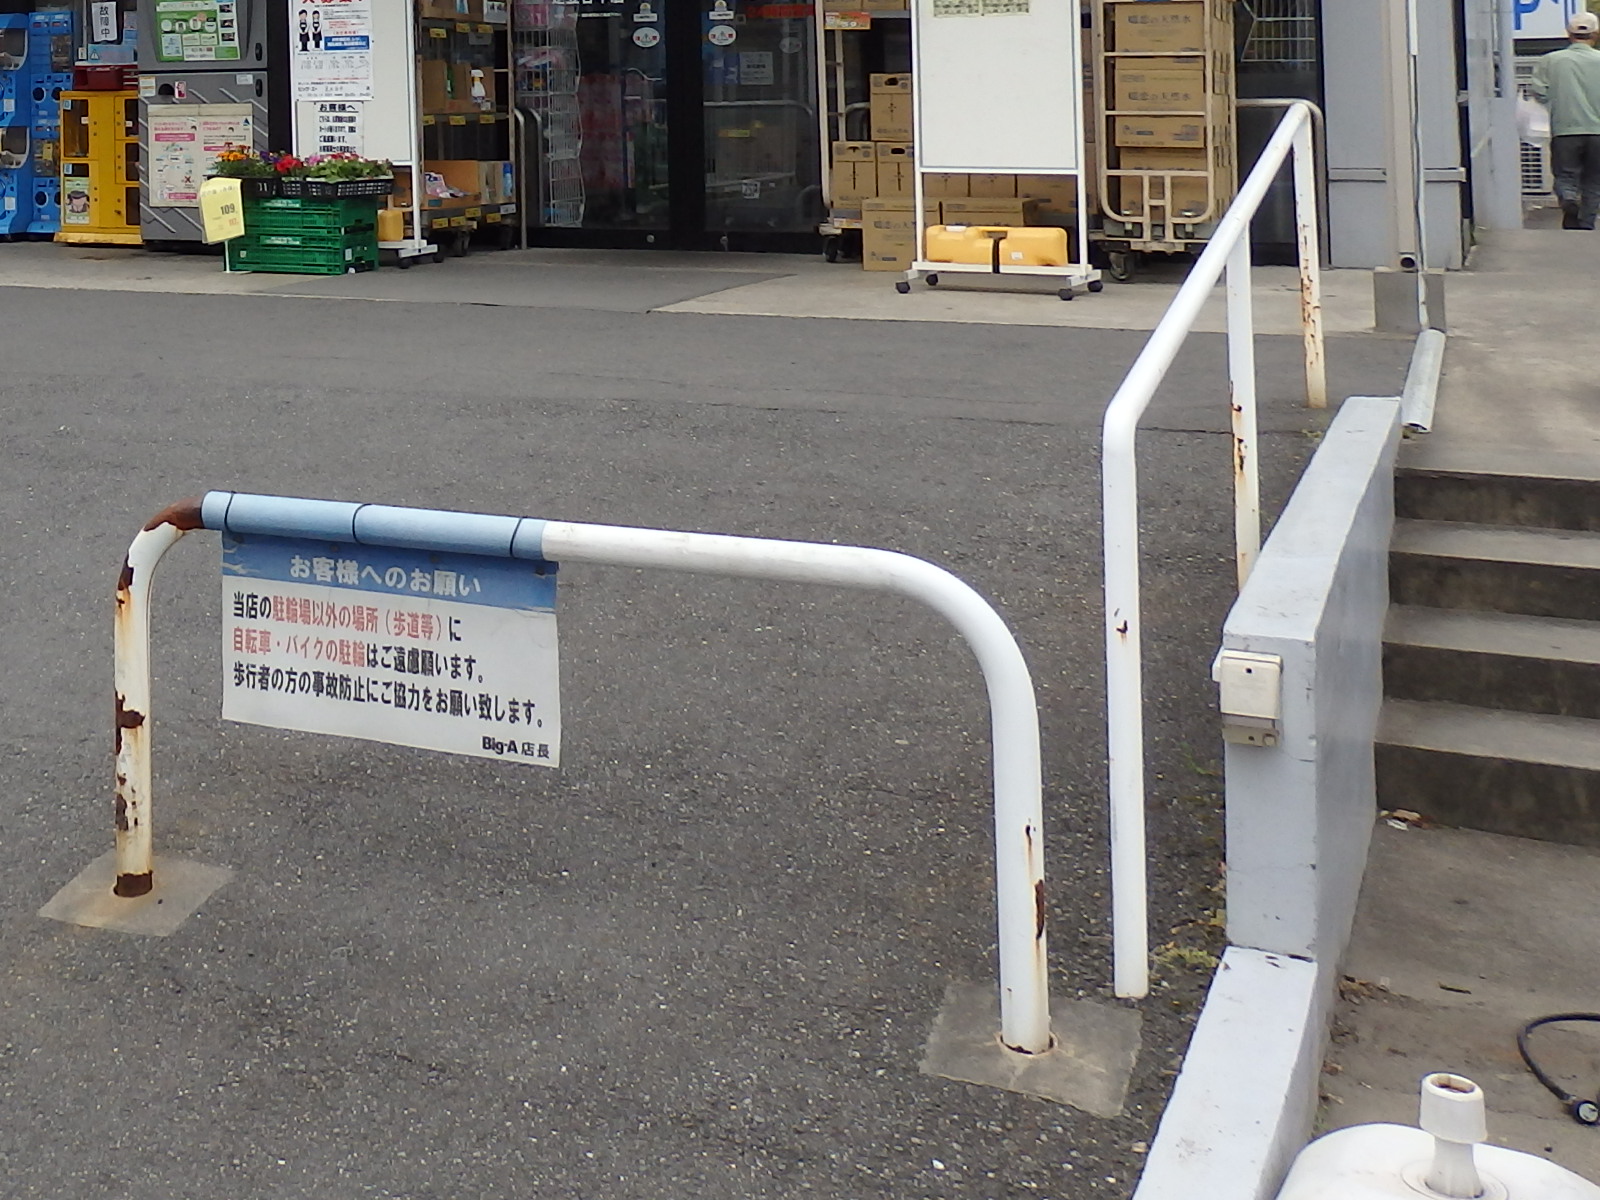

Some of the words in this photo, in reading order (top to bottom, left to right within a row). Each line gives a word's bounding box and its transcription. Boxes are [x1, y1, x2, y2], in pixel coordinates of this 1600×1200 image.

[289, 554, 482, 597] お客様へのお願い
[232, 661, 545, 728] 歩行者の方の事故防止にご協力をお願い致します。
[481, 735, 519, 755] Big-A
[520, 741, 551, 759] 店長
